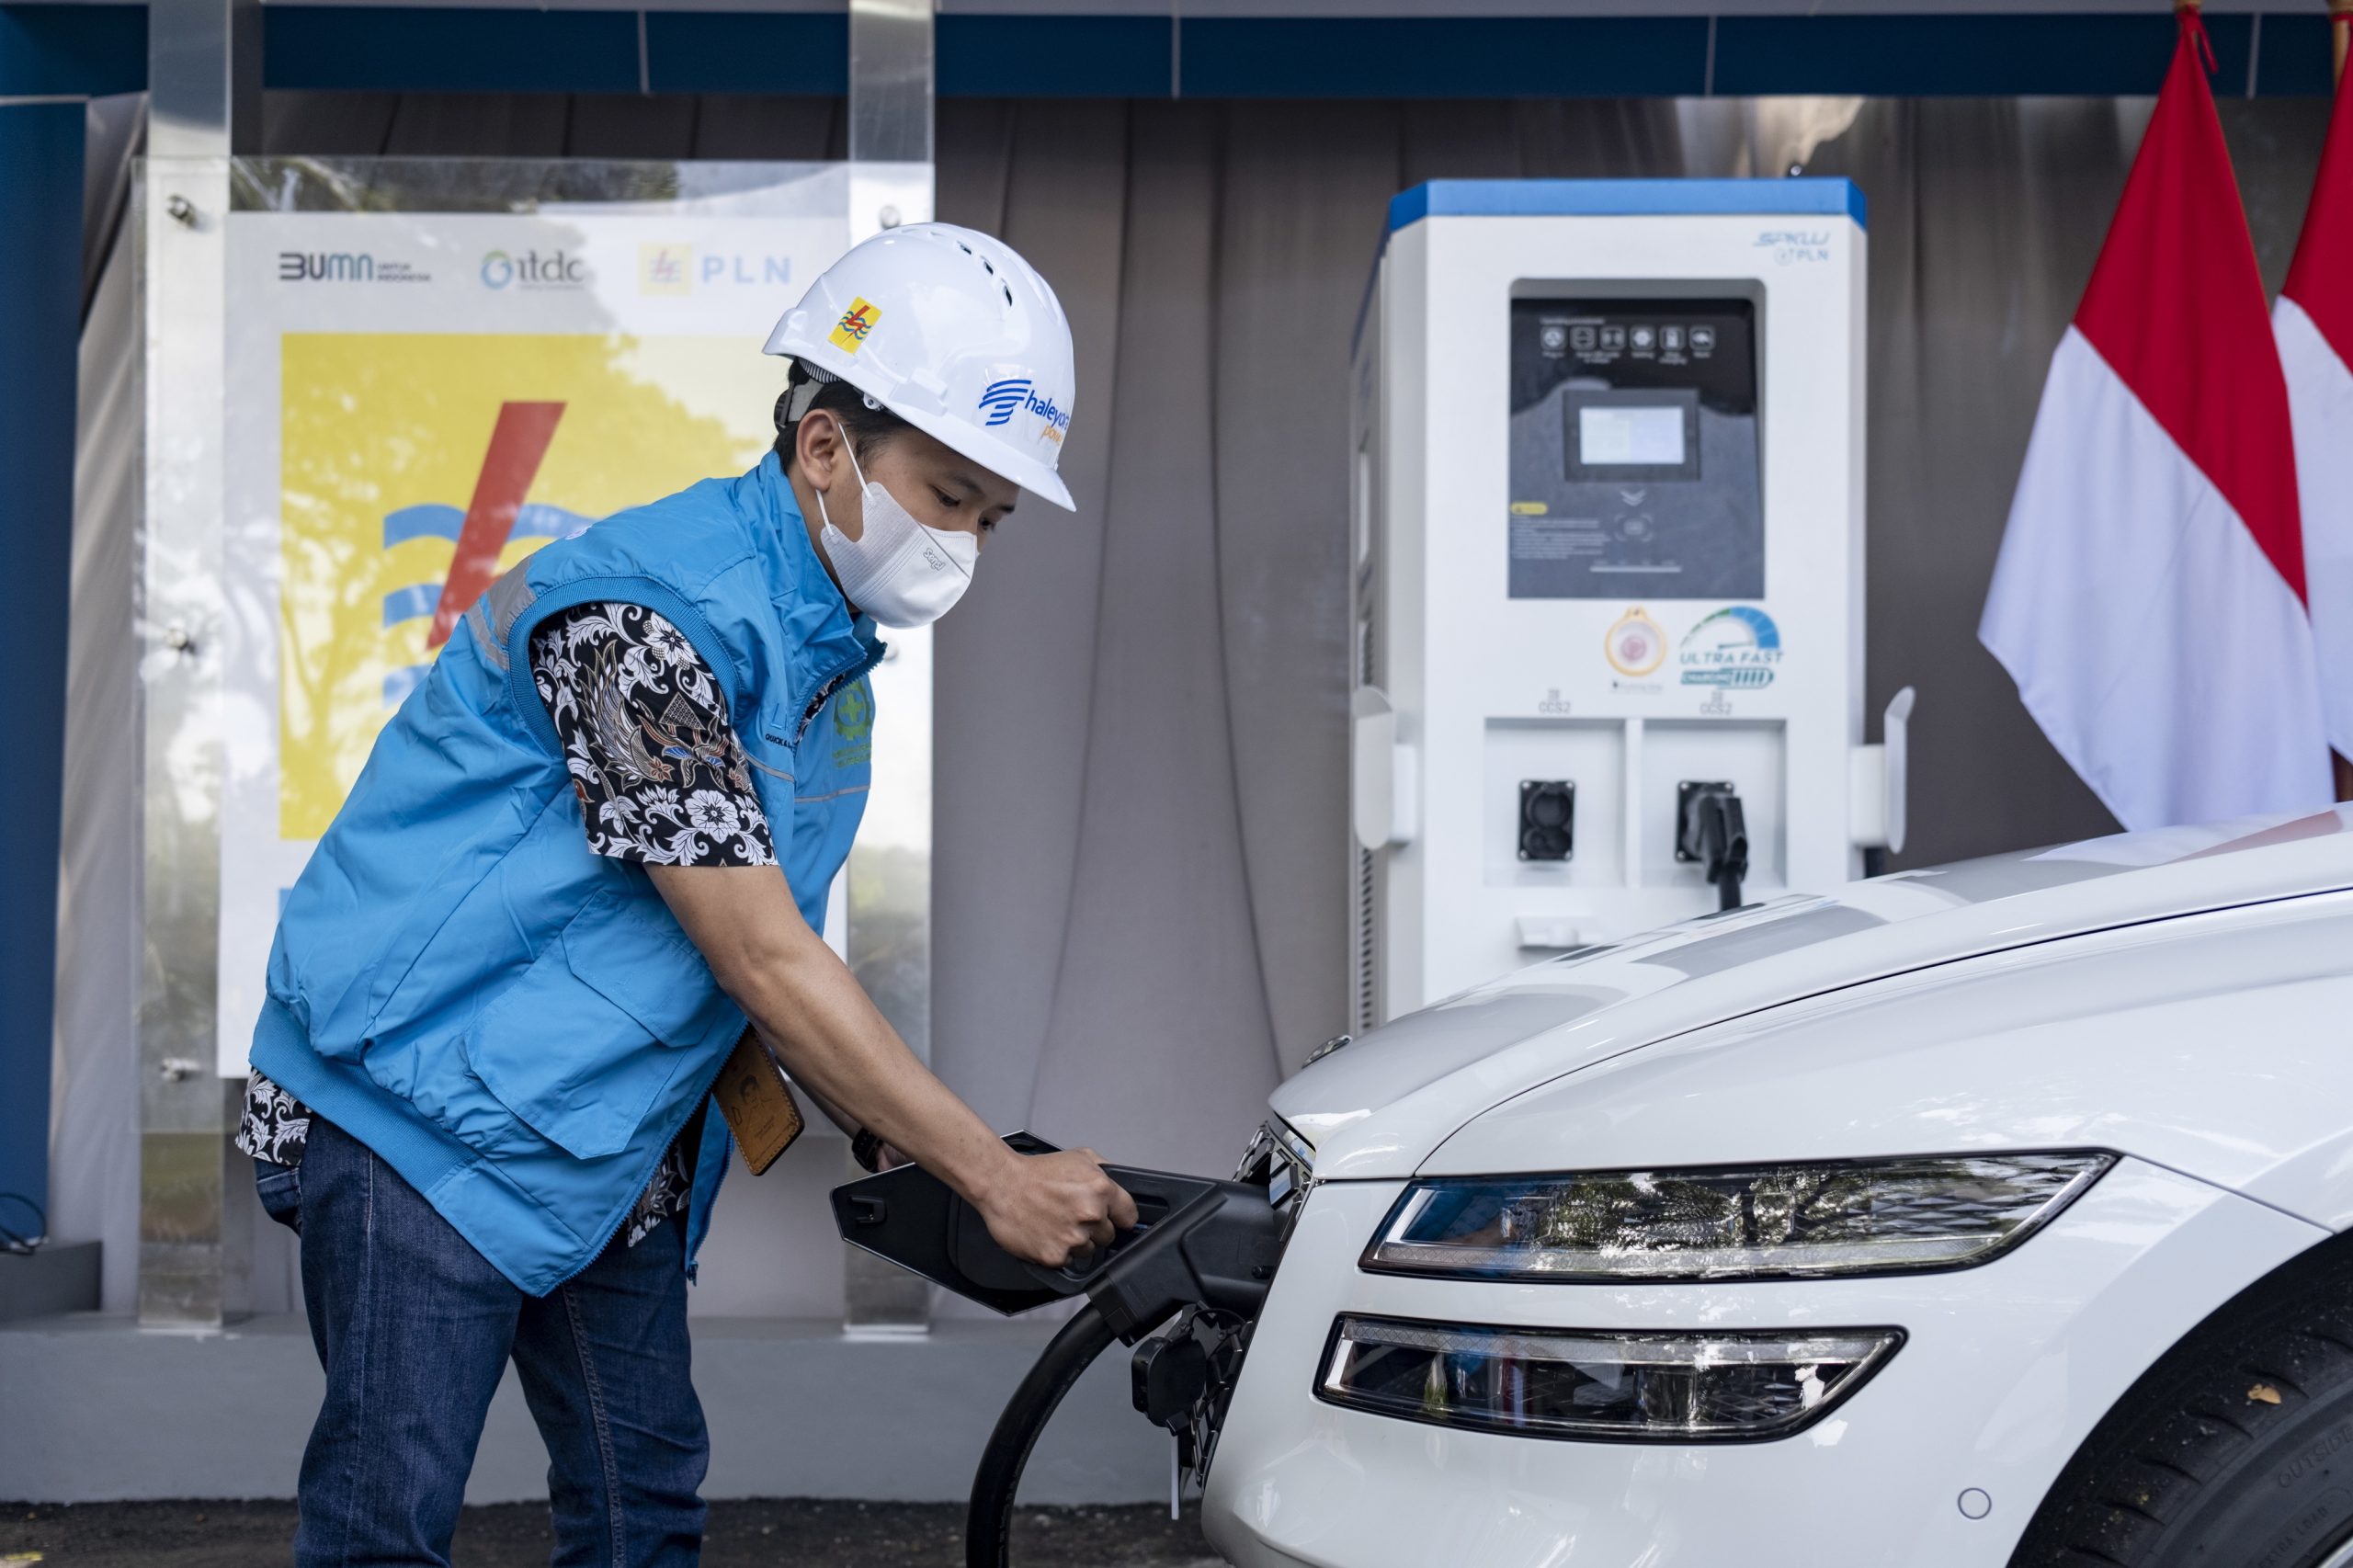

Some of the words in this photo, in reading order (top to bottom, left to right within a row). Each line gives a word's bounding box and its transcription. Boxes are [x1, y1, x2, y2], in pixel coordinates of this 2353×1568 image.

[1796, 248, 1828, 262] PLN
[278, 252, 373, 281] BUMN
[517, 249, 585, 282] itdc
[702, 254, 791, 284] PLN
[1680, 652, 1734, 665] ULTRA
[1740, 651, 1783, 664] FAST
[1538, 700, 1572, 714] CCS2
[1699, 702, 1733, 715] CCS2
